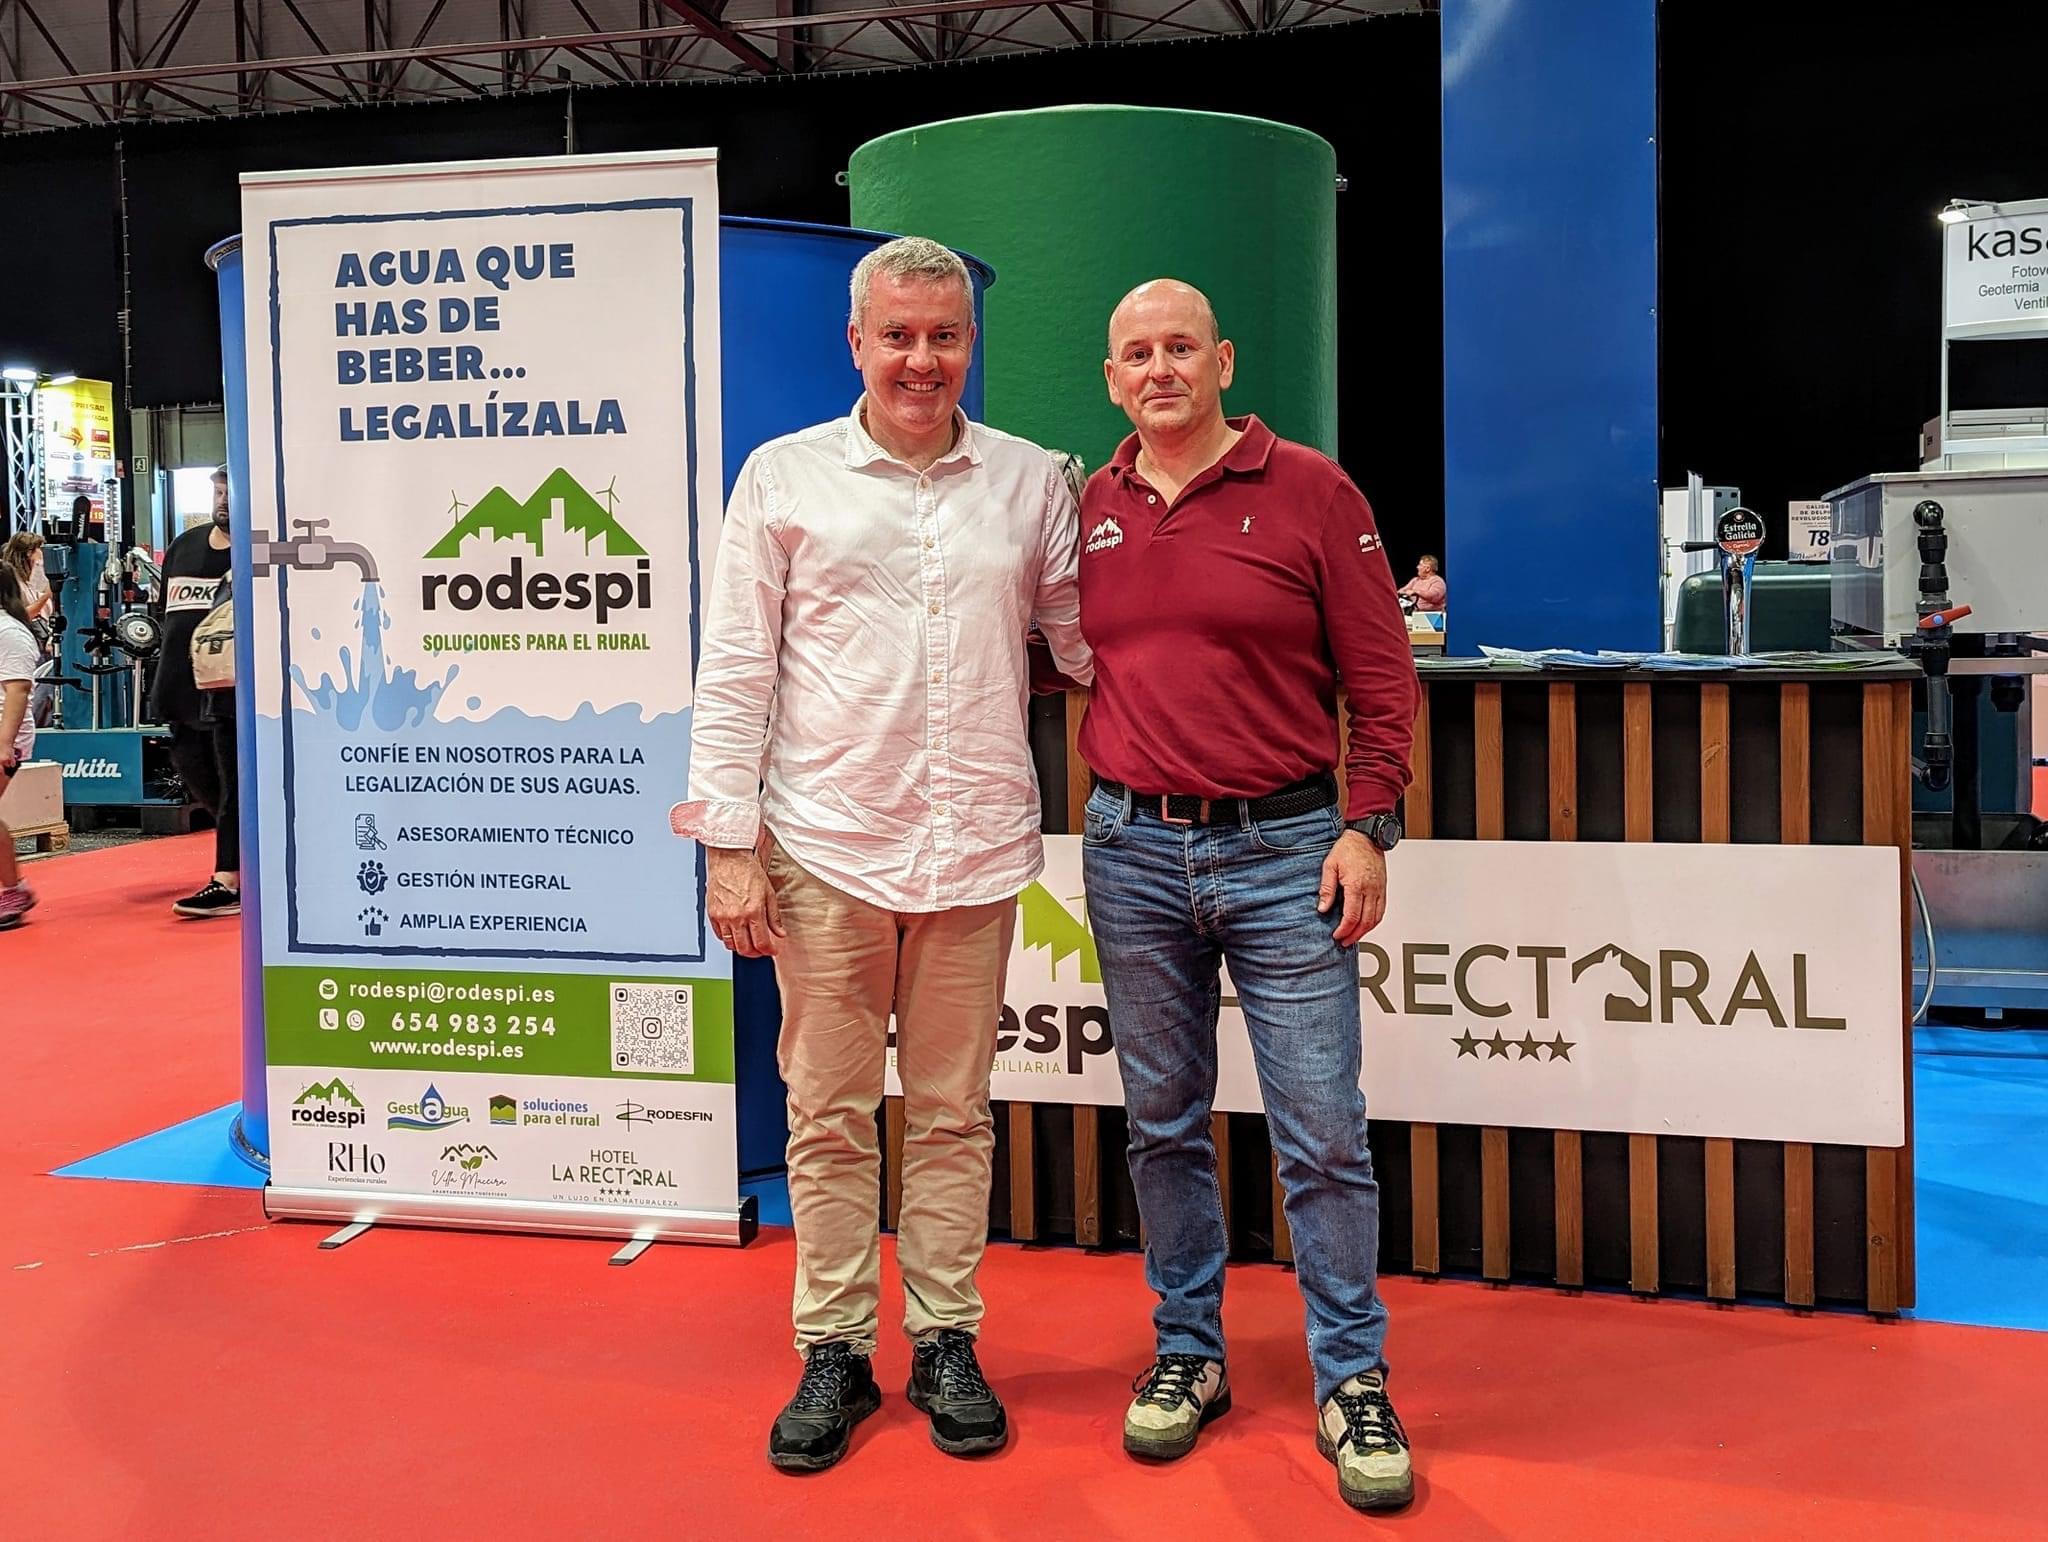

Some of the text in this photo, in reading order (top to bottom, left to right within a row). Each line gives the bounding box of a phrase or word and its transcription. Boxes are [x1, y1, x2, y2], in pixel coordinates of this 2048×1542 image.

[1967, 224, 2048, 262] kas
[334, 243, 576, 291] AGUA QUE
[2011, 264, 2048, 279] Fotov
[1978, 280, 2040, 297] Geotermia
[335, 296, 501, 337] HAS DE
[336, 345, 527, 385] BEBER...
[339, 390, 628, 442] LEGALÍZALA
[1723, 521, 1757, 533] Estrella
[1725, 531, 1756, 541] Galicia
[1085, 532, 1123, 554] rodespi
[421, 556, 652, 625] rodespi
[422, 633, 651, 652] SOLUCIONES PARA EL RURAL
[340, 743, 645, 765] CONFÍE EN NOSOTROS PARA LA
[62, 758, 122, 778] akita
[345, 772, 641, 795] LEGALIZACIÓN DE SUS AGUAS.
[396, 825, 634, 845] ASESORAMIENTO TÉCNICO
[396, 869, 571, 891] GESTIÓN INTEGRAL
[399, 913, 588, 933] AMPLIA EXPERIENCIA
[349, 981, 556, 1005] rodespi@rodespi.es
[391, 1012, 556, 1036] 654 983 254
[369, 1038, 524, 1061] www.rodespi.es
[522, 1098, 589, 1113] soluciones
[646, 1109, 713, 1123] RODESFIN
[291, 1105, 366, 1129] rodespi
[522, 1112, 600, 1127] para el rural
[328, 1141, 386, 1175] RHo
[590, 1149, 639, 1165] HOTEL
[552, 1163, 575, 1183] LA
[567, 1194, 590, 1202] LUJO
[622, 1197, 680, 1208] NATURALEZA
